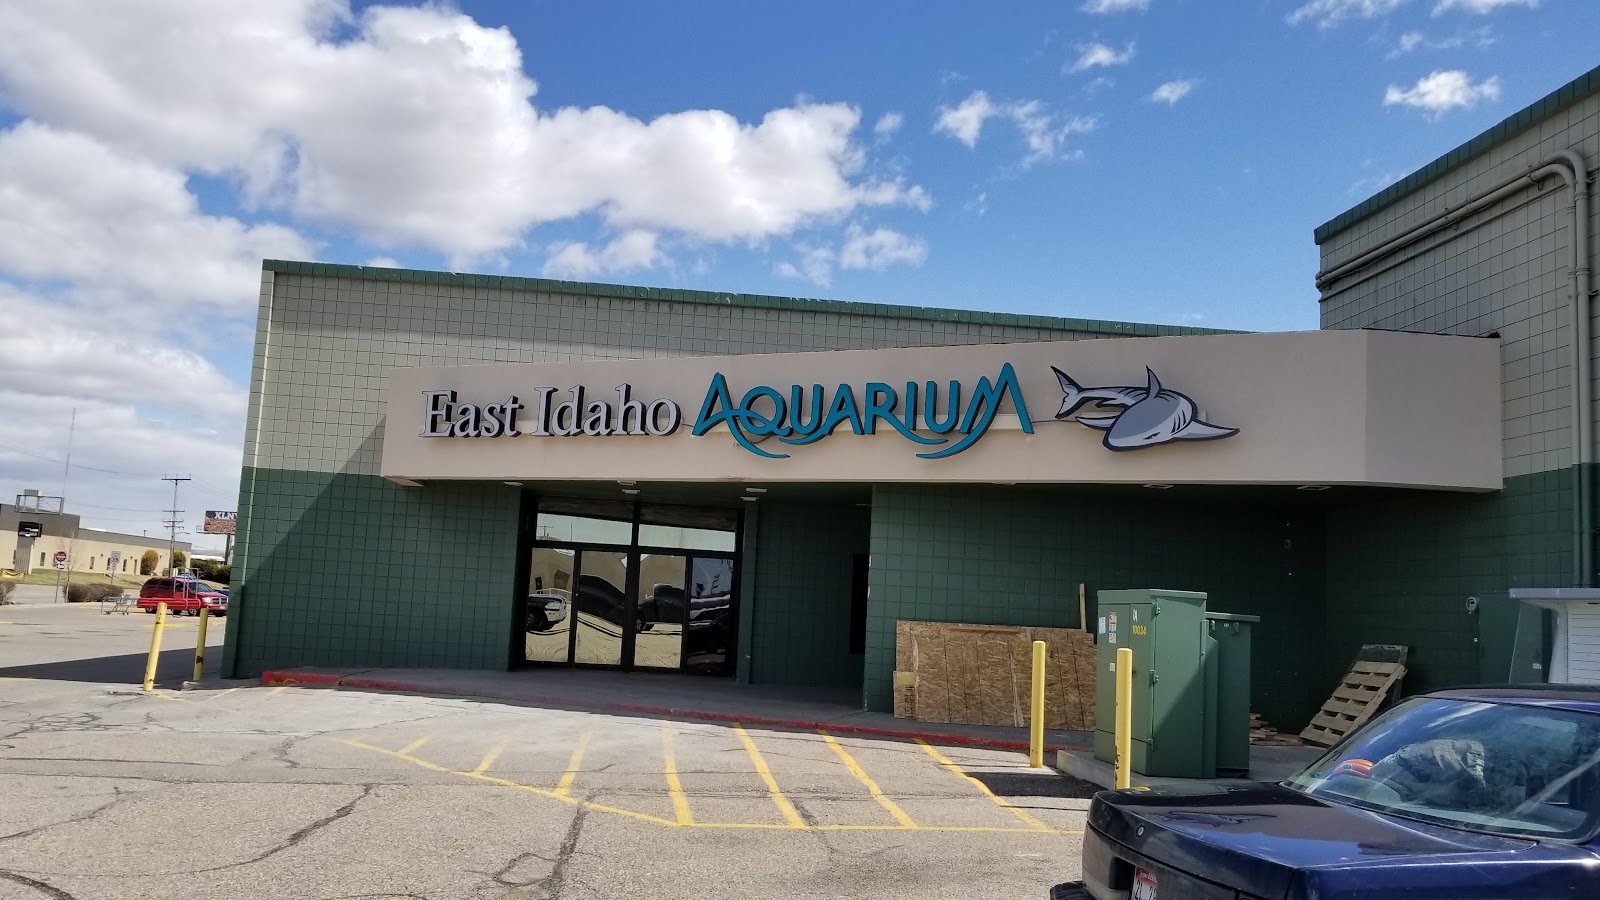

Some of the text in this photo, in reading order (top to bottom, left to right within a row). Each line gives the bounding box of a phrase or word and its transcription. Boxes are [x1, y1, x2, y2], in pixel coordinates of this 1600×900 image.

[418, 362, 1035, 458] East Idaho AQUARIUM
